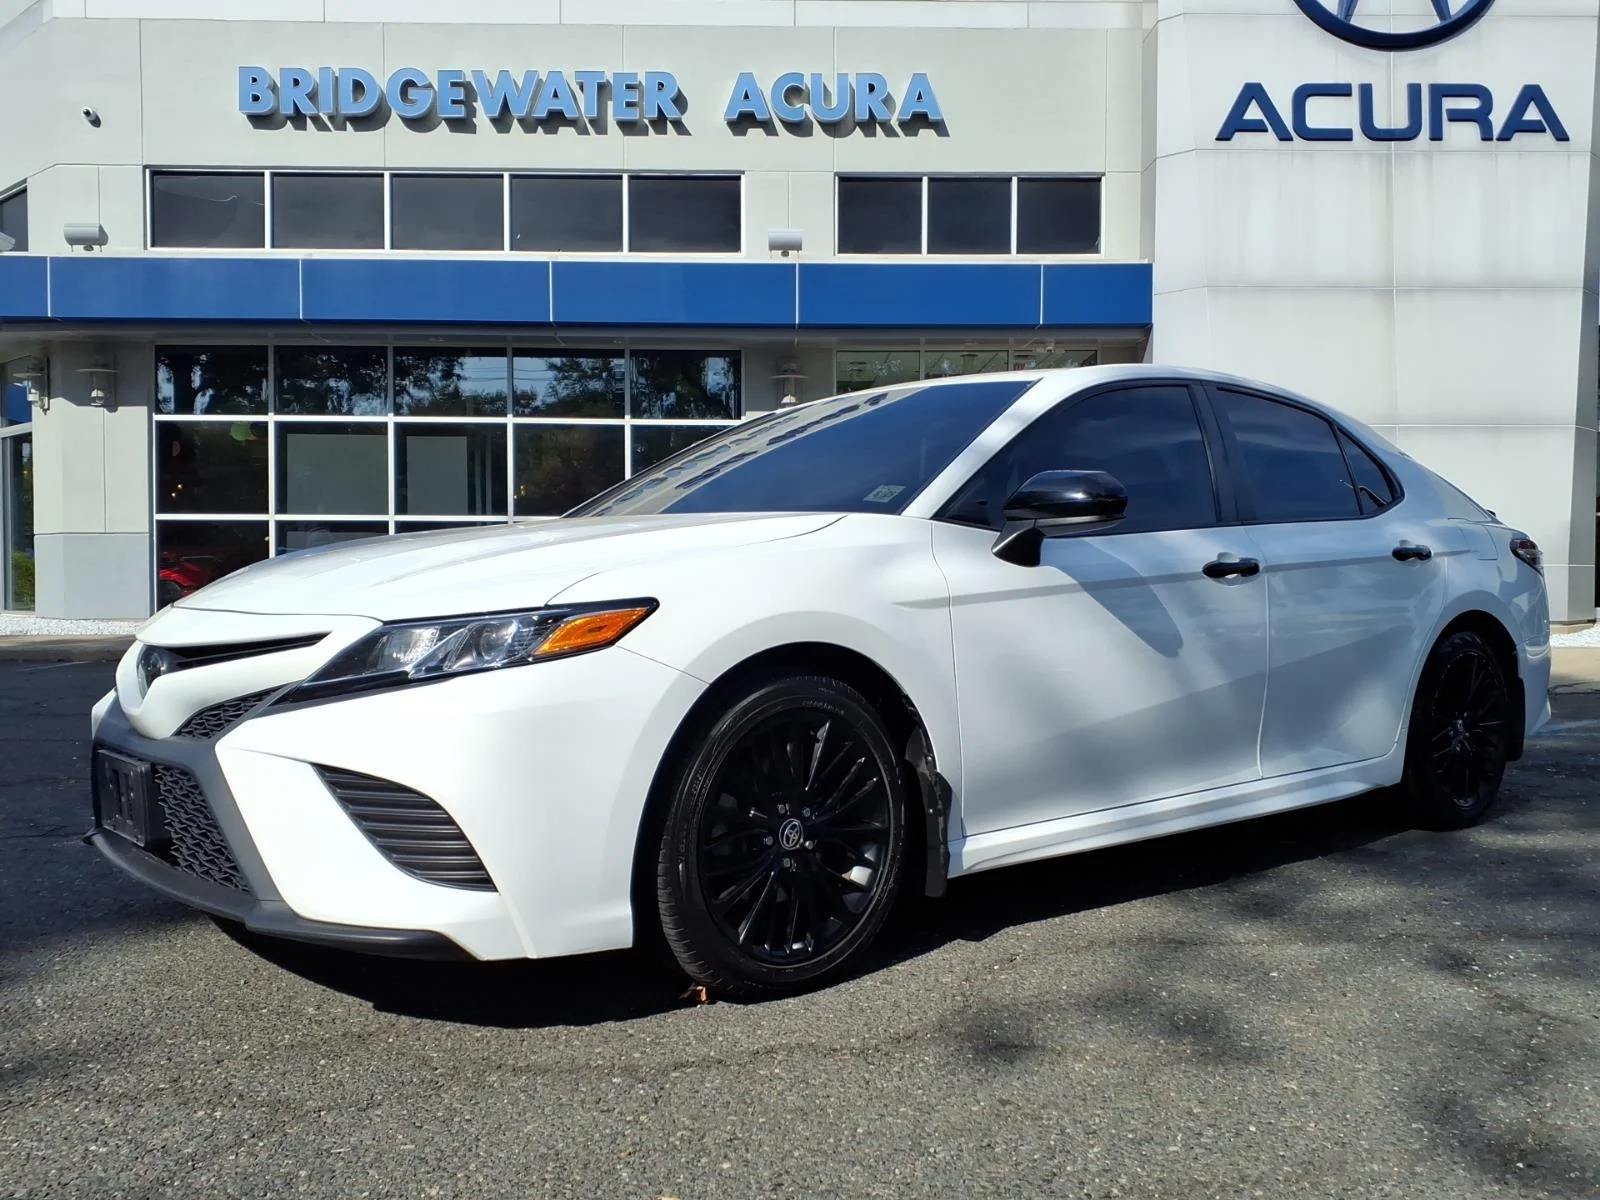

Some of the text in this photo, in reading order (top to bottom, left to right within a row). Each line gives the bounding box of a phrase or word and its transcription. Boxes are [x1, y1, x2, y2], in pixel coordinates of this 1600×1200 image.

[238, 66, 943, 122] BRIDGEWATER ACURA
[1215, 82, 1570, 141] ACURA
